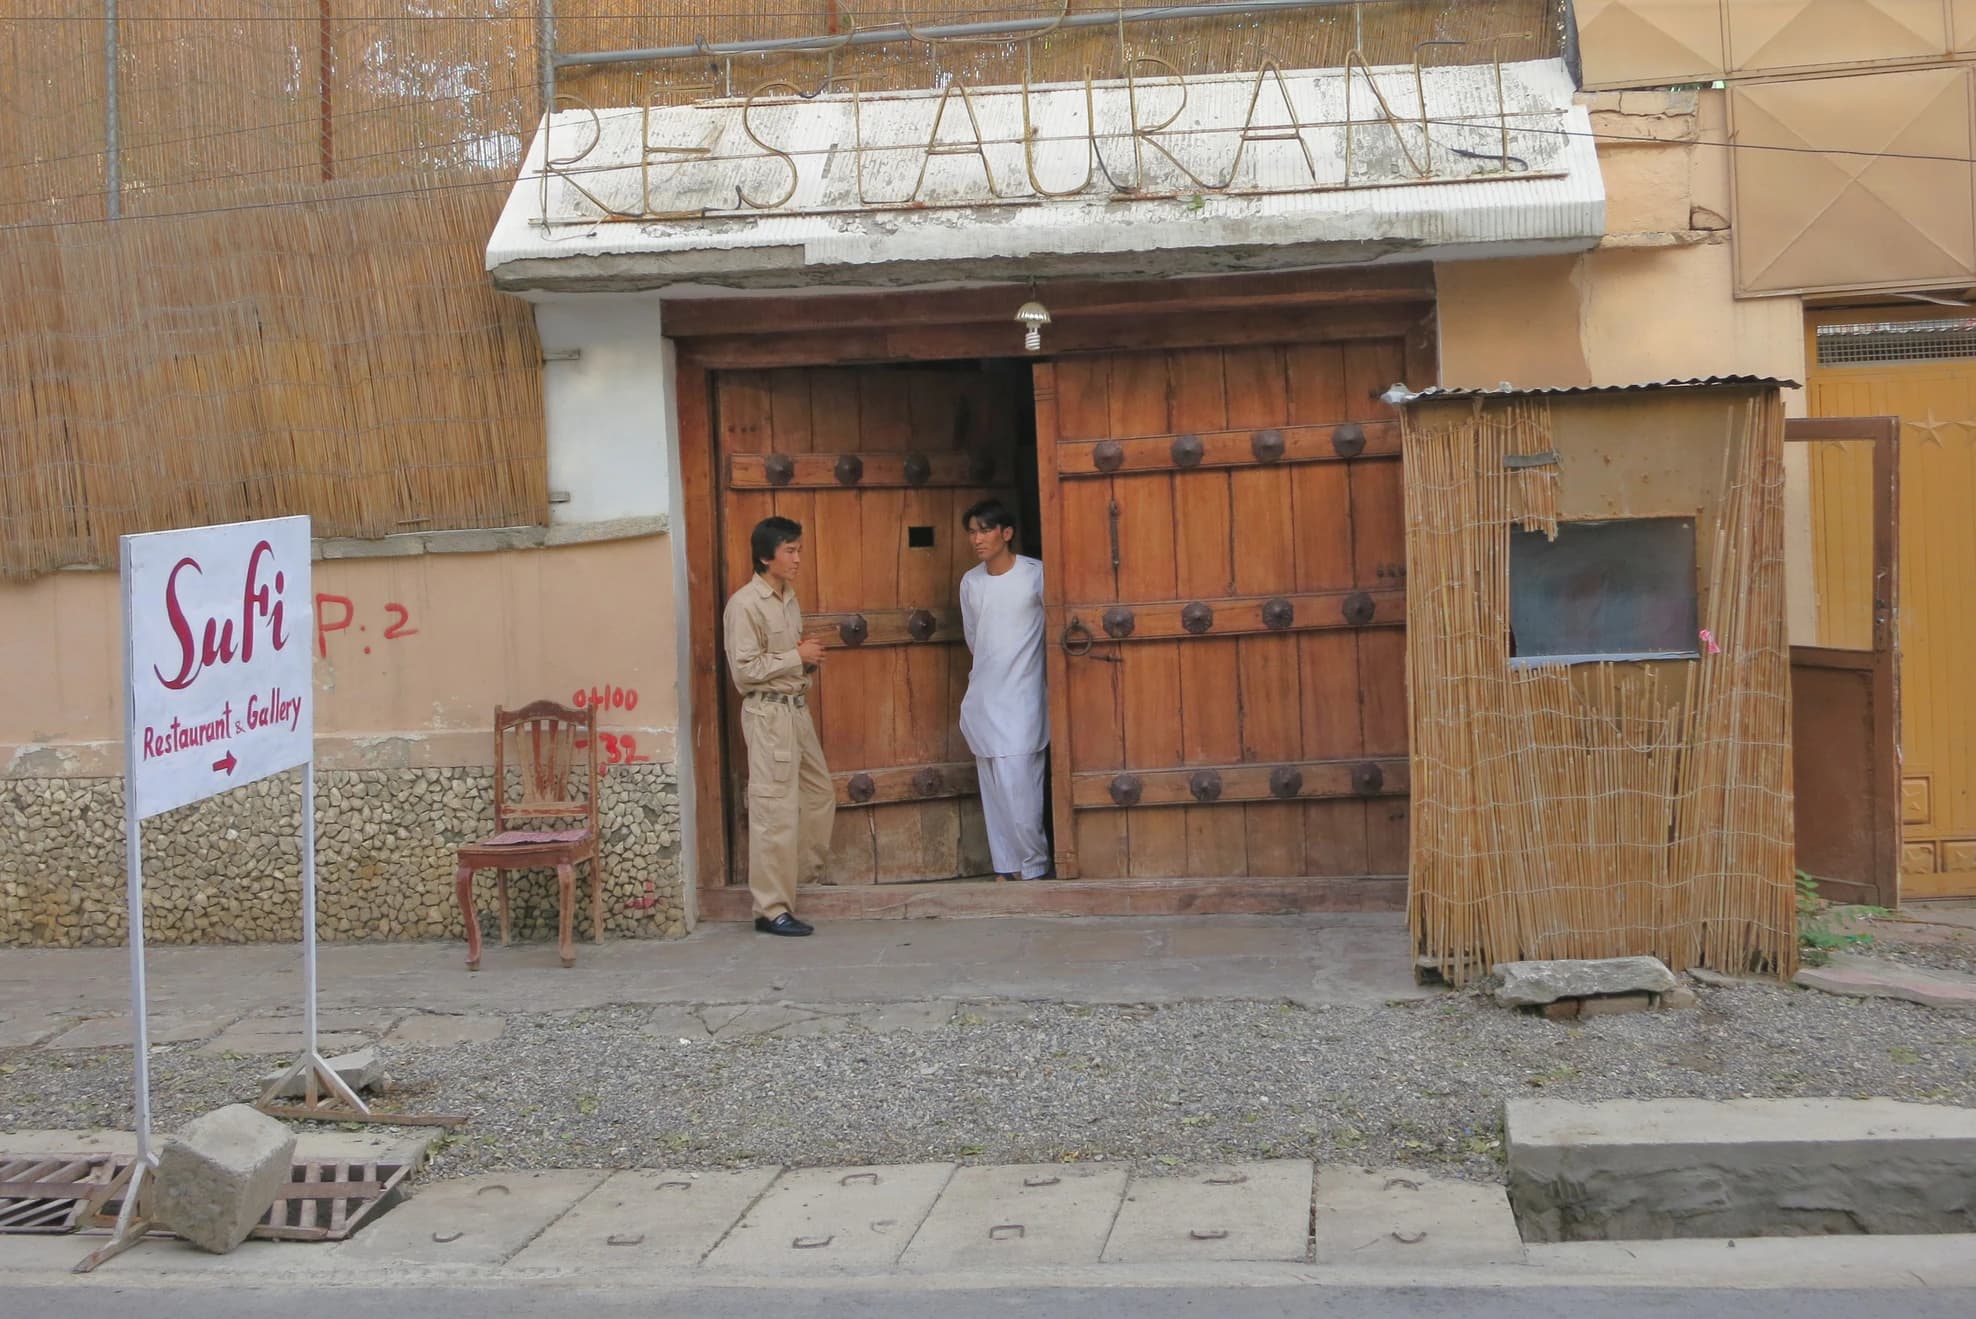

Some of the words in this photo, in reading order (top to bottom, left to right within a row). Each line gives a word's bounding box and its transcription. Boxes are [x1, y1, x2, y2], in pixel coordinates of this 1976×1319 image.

[540, 33, 1530, 234] RESTAURANT
[143, 701, 233, 762] Restaurant
[235, 721, 246, 735] &
[247, 688, 302, 732] Gallery
